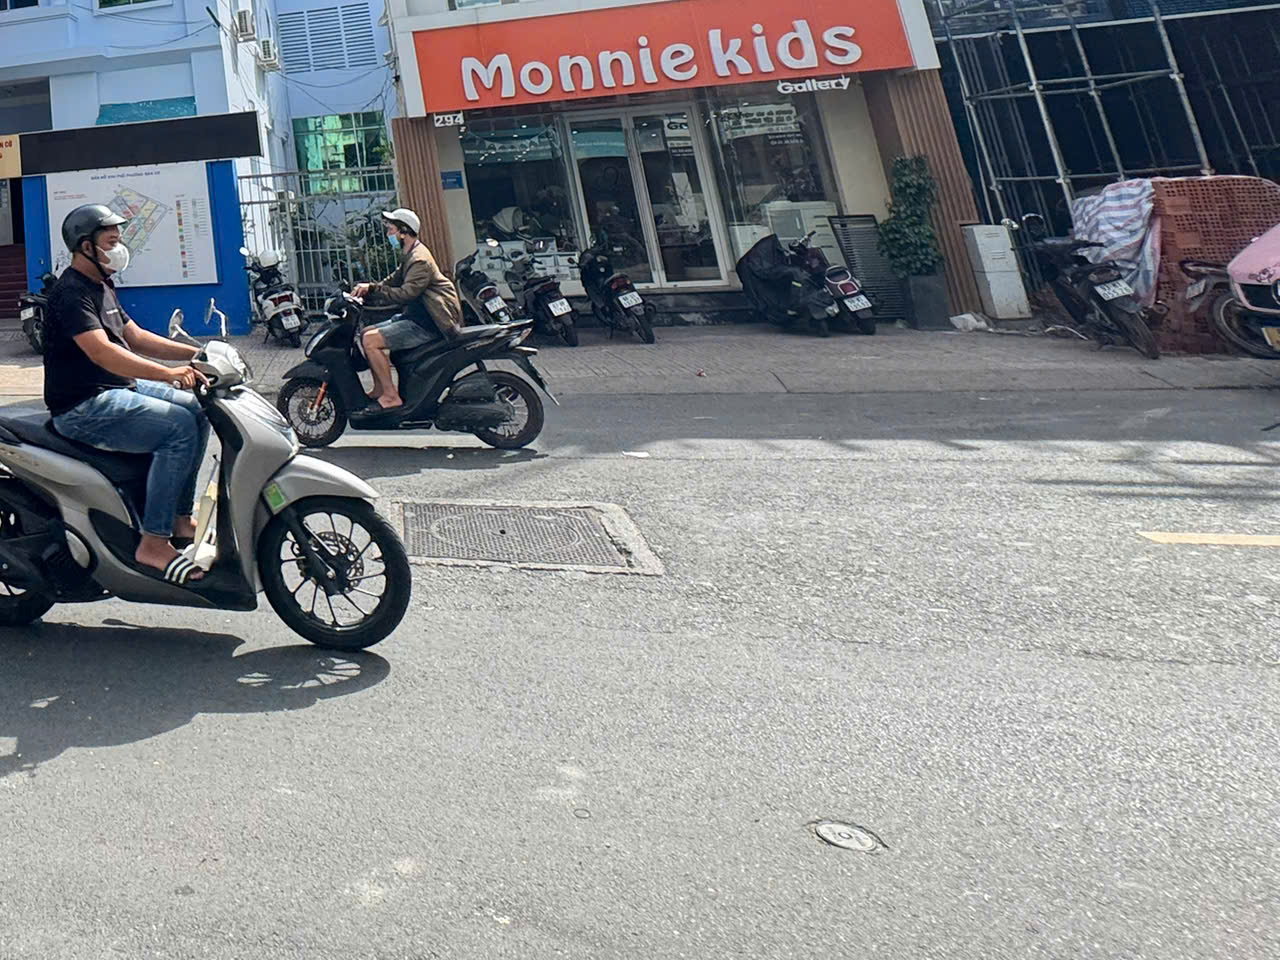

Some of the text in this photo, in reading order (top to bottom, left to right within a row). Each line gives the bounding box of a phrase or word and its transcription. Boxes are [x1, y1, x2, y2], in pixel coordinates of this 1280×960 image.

[460, 18, 863, 102] Monnie kids
[777, 75, 851, 94] Gallery
[435, 112, 463, 127] 294
